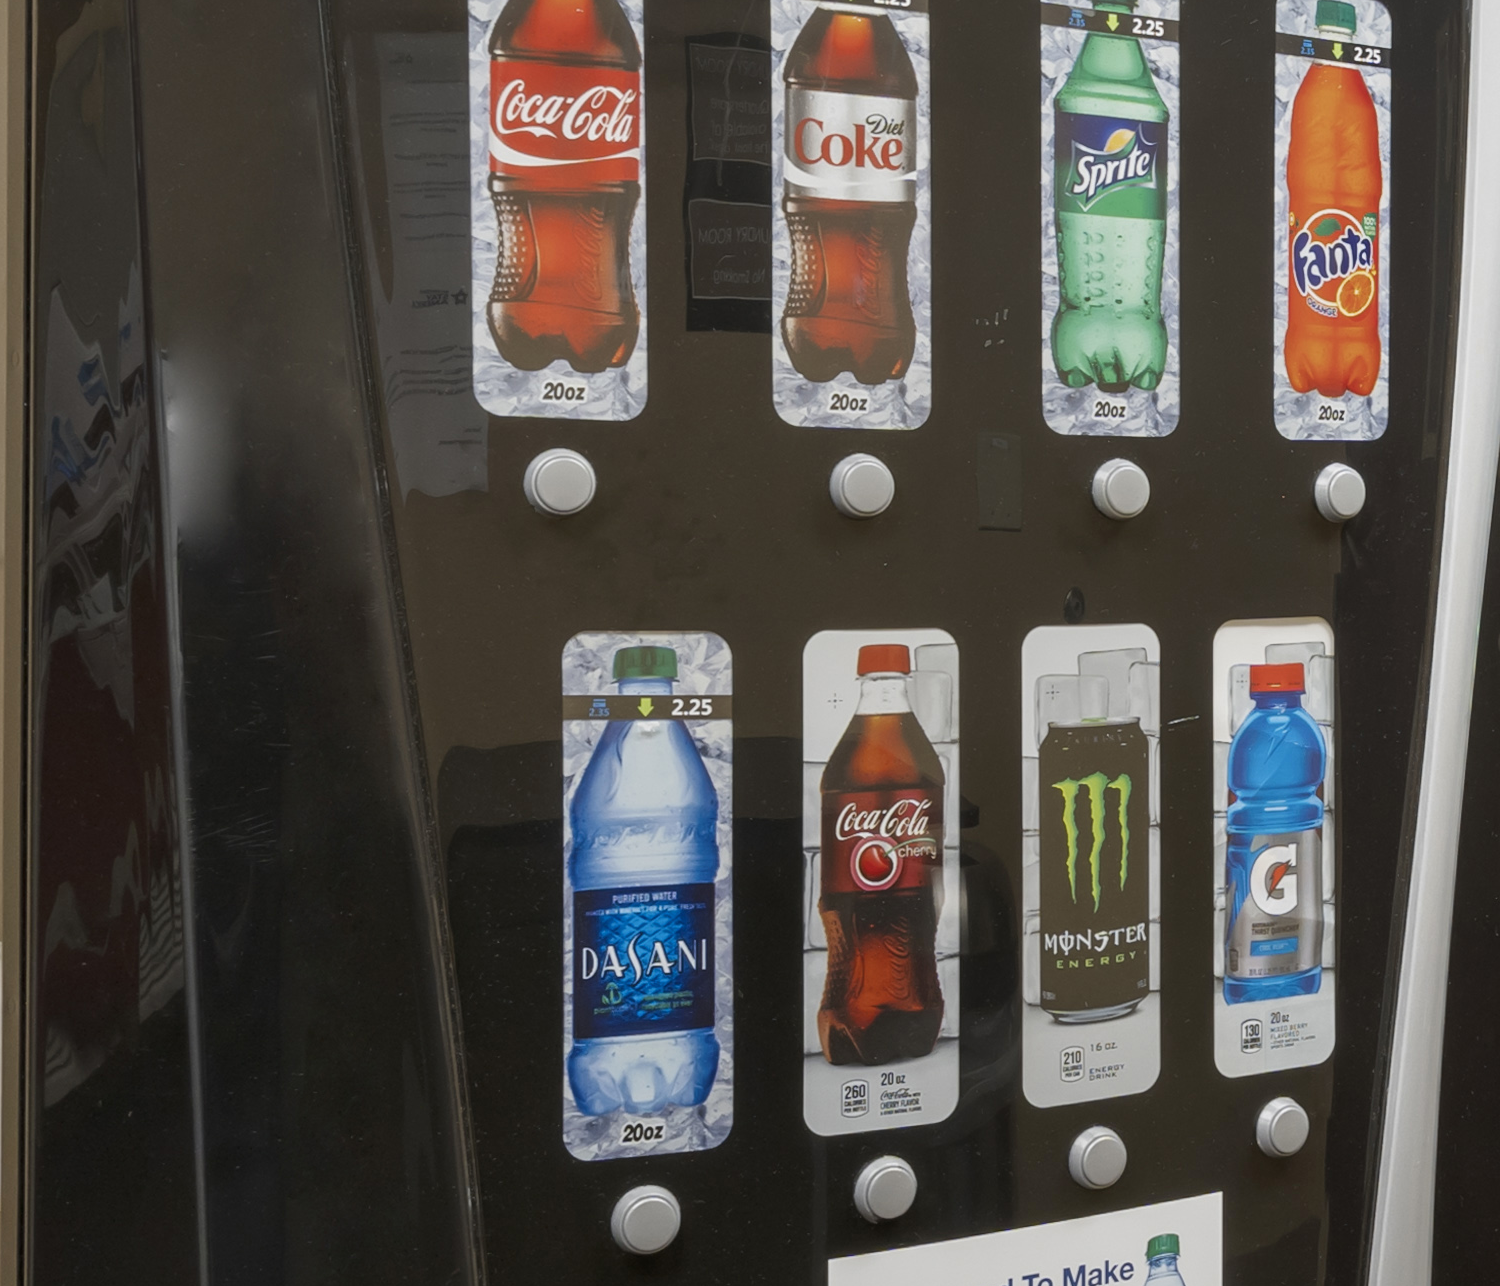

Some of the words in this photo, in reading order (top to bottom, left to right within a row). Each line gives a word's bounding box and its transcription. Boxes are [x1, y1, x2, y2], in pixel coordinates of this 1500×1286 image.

[1132, 17, 1165, 37] 2.25
[1354, 45, 1382, 65] 2.25
[496, 79, 638, 143] Coca-Cola
[866, 113, 906, 136] Diet
[794, 117, 905, 172] Coke
[1072, 150, 1151, 198] Sprite
[1293, 228, 1373, 295] Fanta
[542, 381, 586, 402] 20oz
[829, 393, 868, 412] 20oz
[1093, 401, 1127, 419] 20oz
[1317, 404, 1346, 422] 20oz
[671, 698, 714, 717] 2.25
[835, 798, 933, 842] Coca-Cola
[897, 844, 938, 860] cherry
[1250, 843, 1299, 917] G
[612, 892, 650, 905] PURIFIED
[651, 891, 678, 903] WATER
[1043, 921, 1148, 956] MONSTER
[581, 933, 709, 987] DASANI
[1065, 950, 1128, 970] ENERGY
[1270, 1011, 1281, 1024] 20
[1281, 1014, 1290, 1023] oz
[1244, 1023, 1260, 1038] 130
[1090, 1042, 1103, 1052] 16
[1063, 1050, 1082, 1066] 210
[1088, 1063, 1125, 1075] ENERGY
[1088, 1072, 1118, 1082] DRINK
[880, 1072, 894, 1087] 20
[895, 1074, 906, 1085] oz
[844, 1083, 866, 1100] 260
[621, 1122, 664, 1143] 20oz
